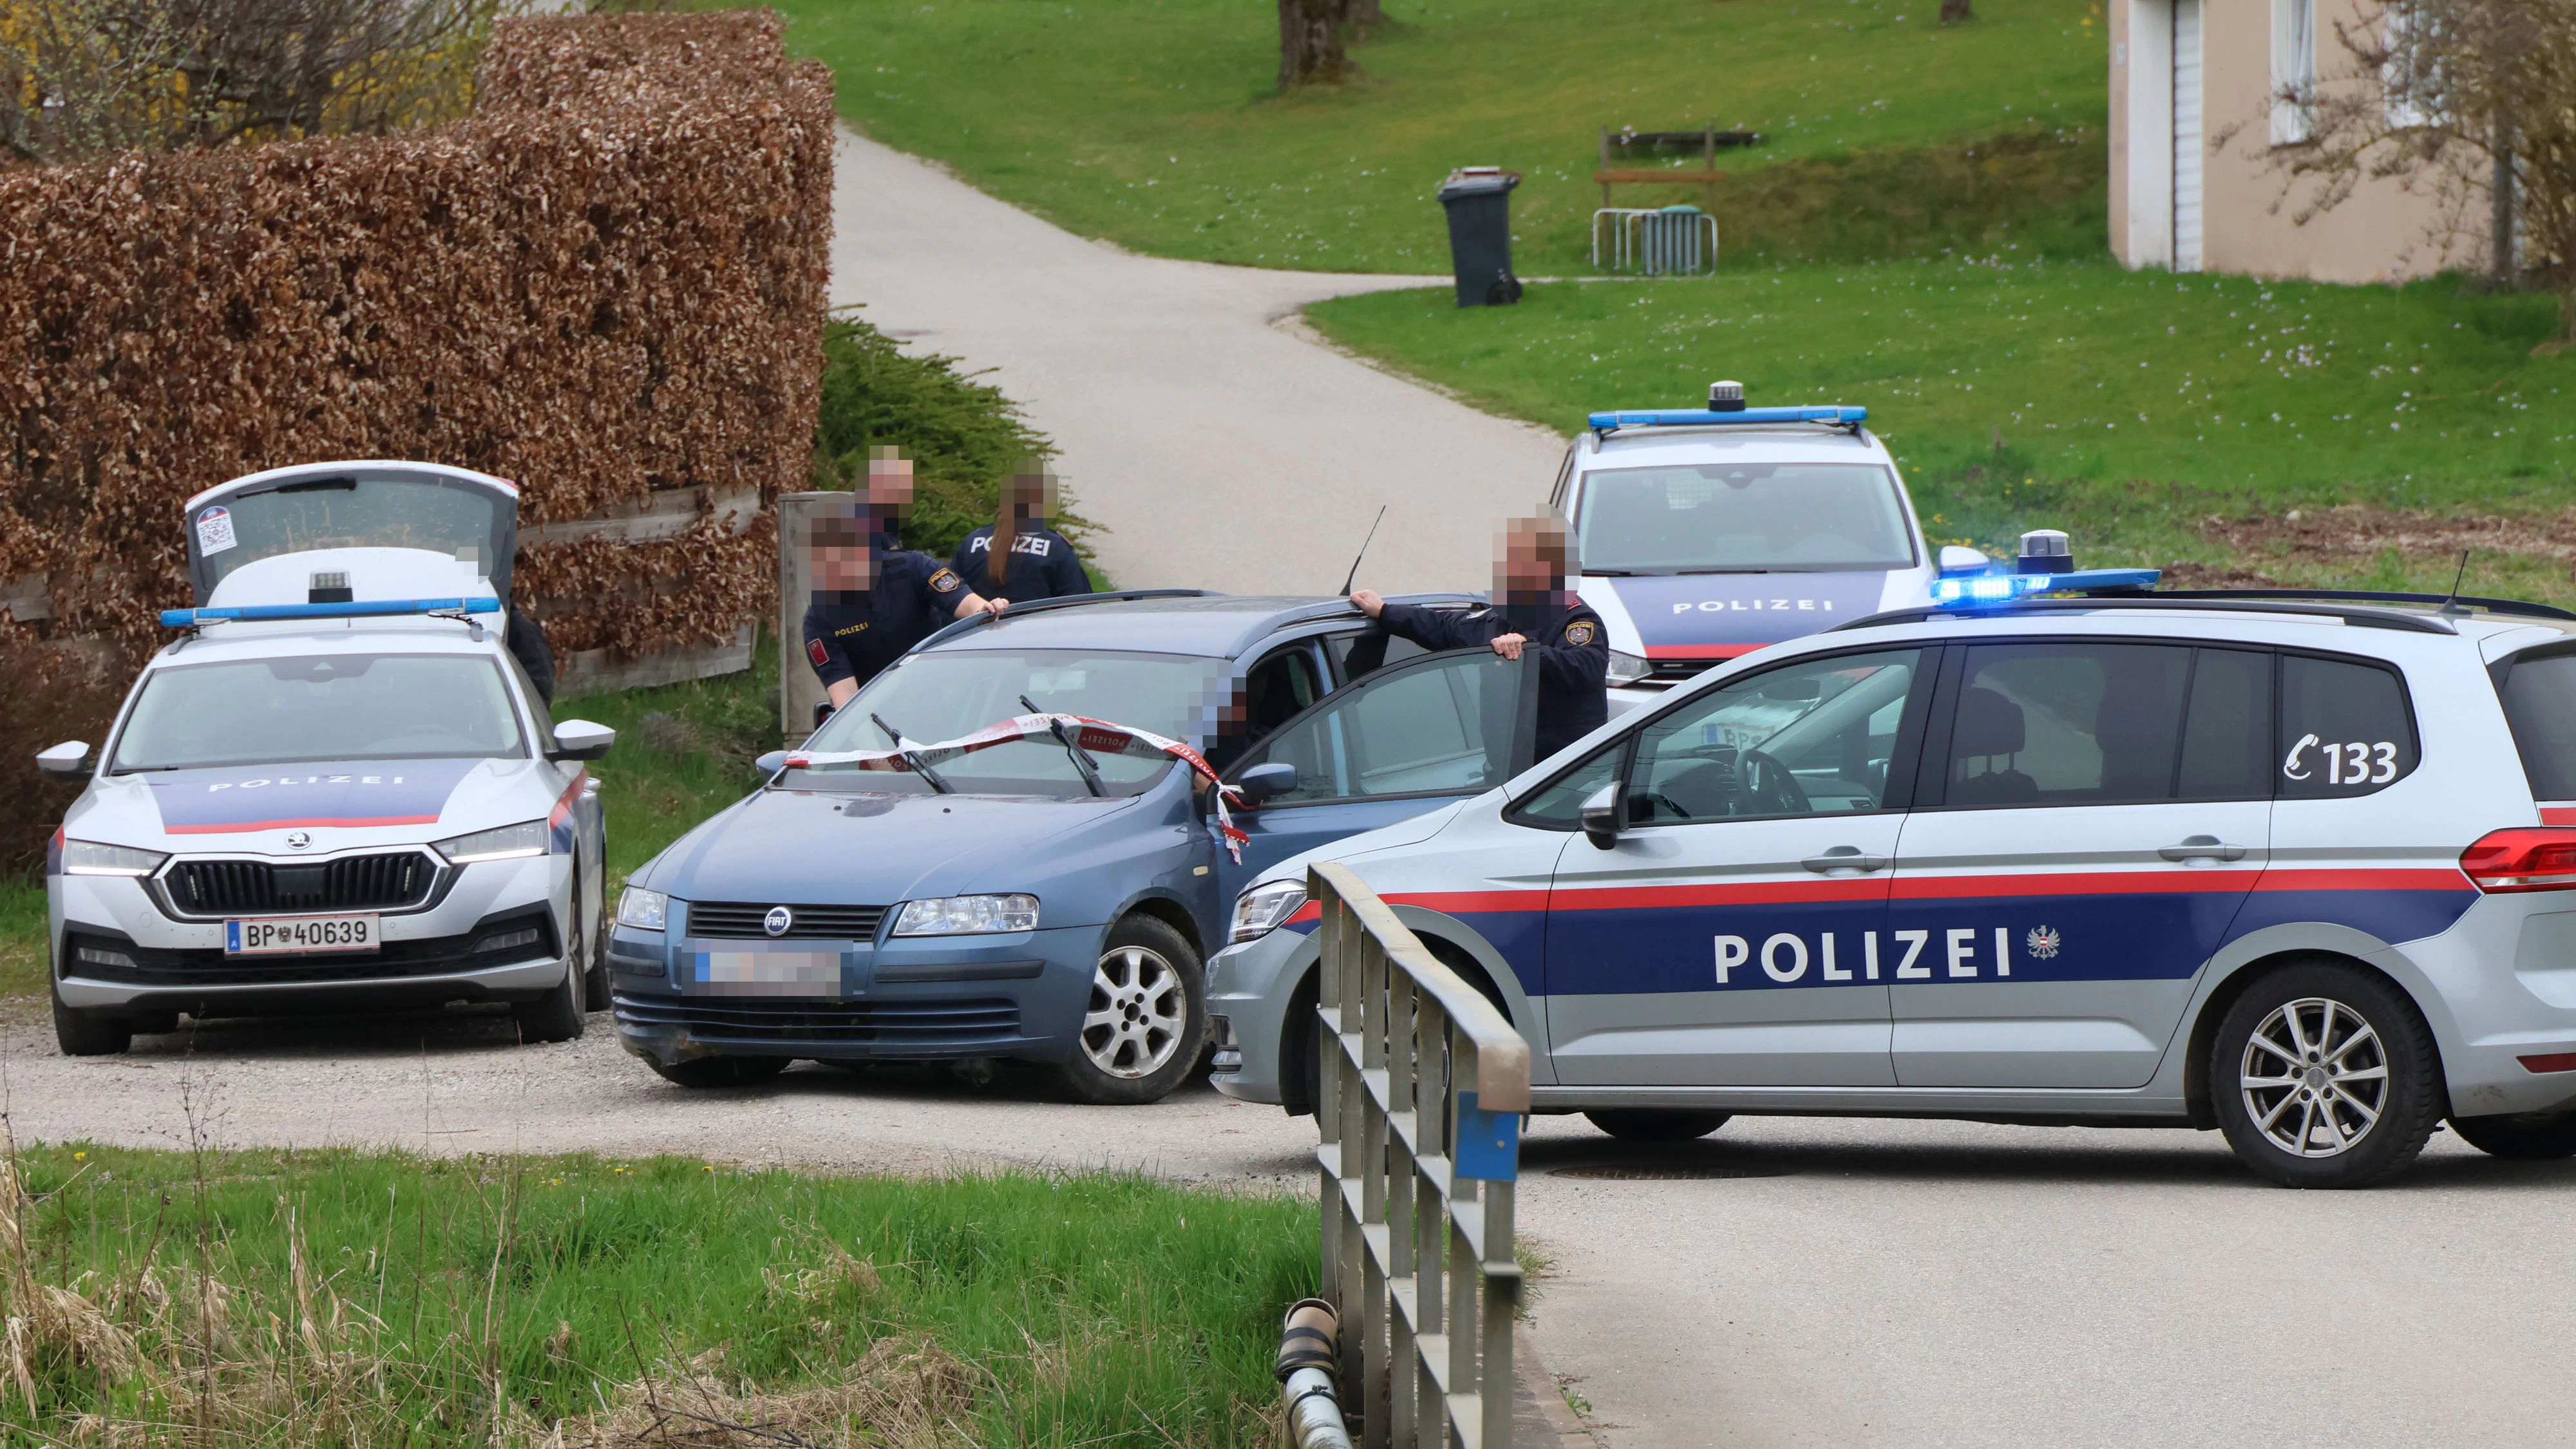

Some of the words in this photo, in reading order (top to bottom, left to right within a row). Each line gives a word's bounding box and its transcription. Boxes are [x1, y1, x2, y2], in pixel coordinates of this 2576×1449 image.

[970, 535, 1051, 557] POIZEI
[1673, 599, 1832, 614] POLIZEI
[835, 621, 869, 638] POLIZEI
[1088, 734, 1126, 748] POLIZEI
[2322, 741, 2396, 784] 133
[209, 775, 404, 792] POLIZEI
[768, 916, 786, 926] FIAT
[247, 925, 275, 947] BP
[294, 921, 367, 945] 40639
[1714, 927, 2010, 983] POLIZEI
